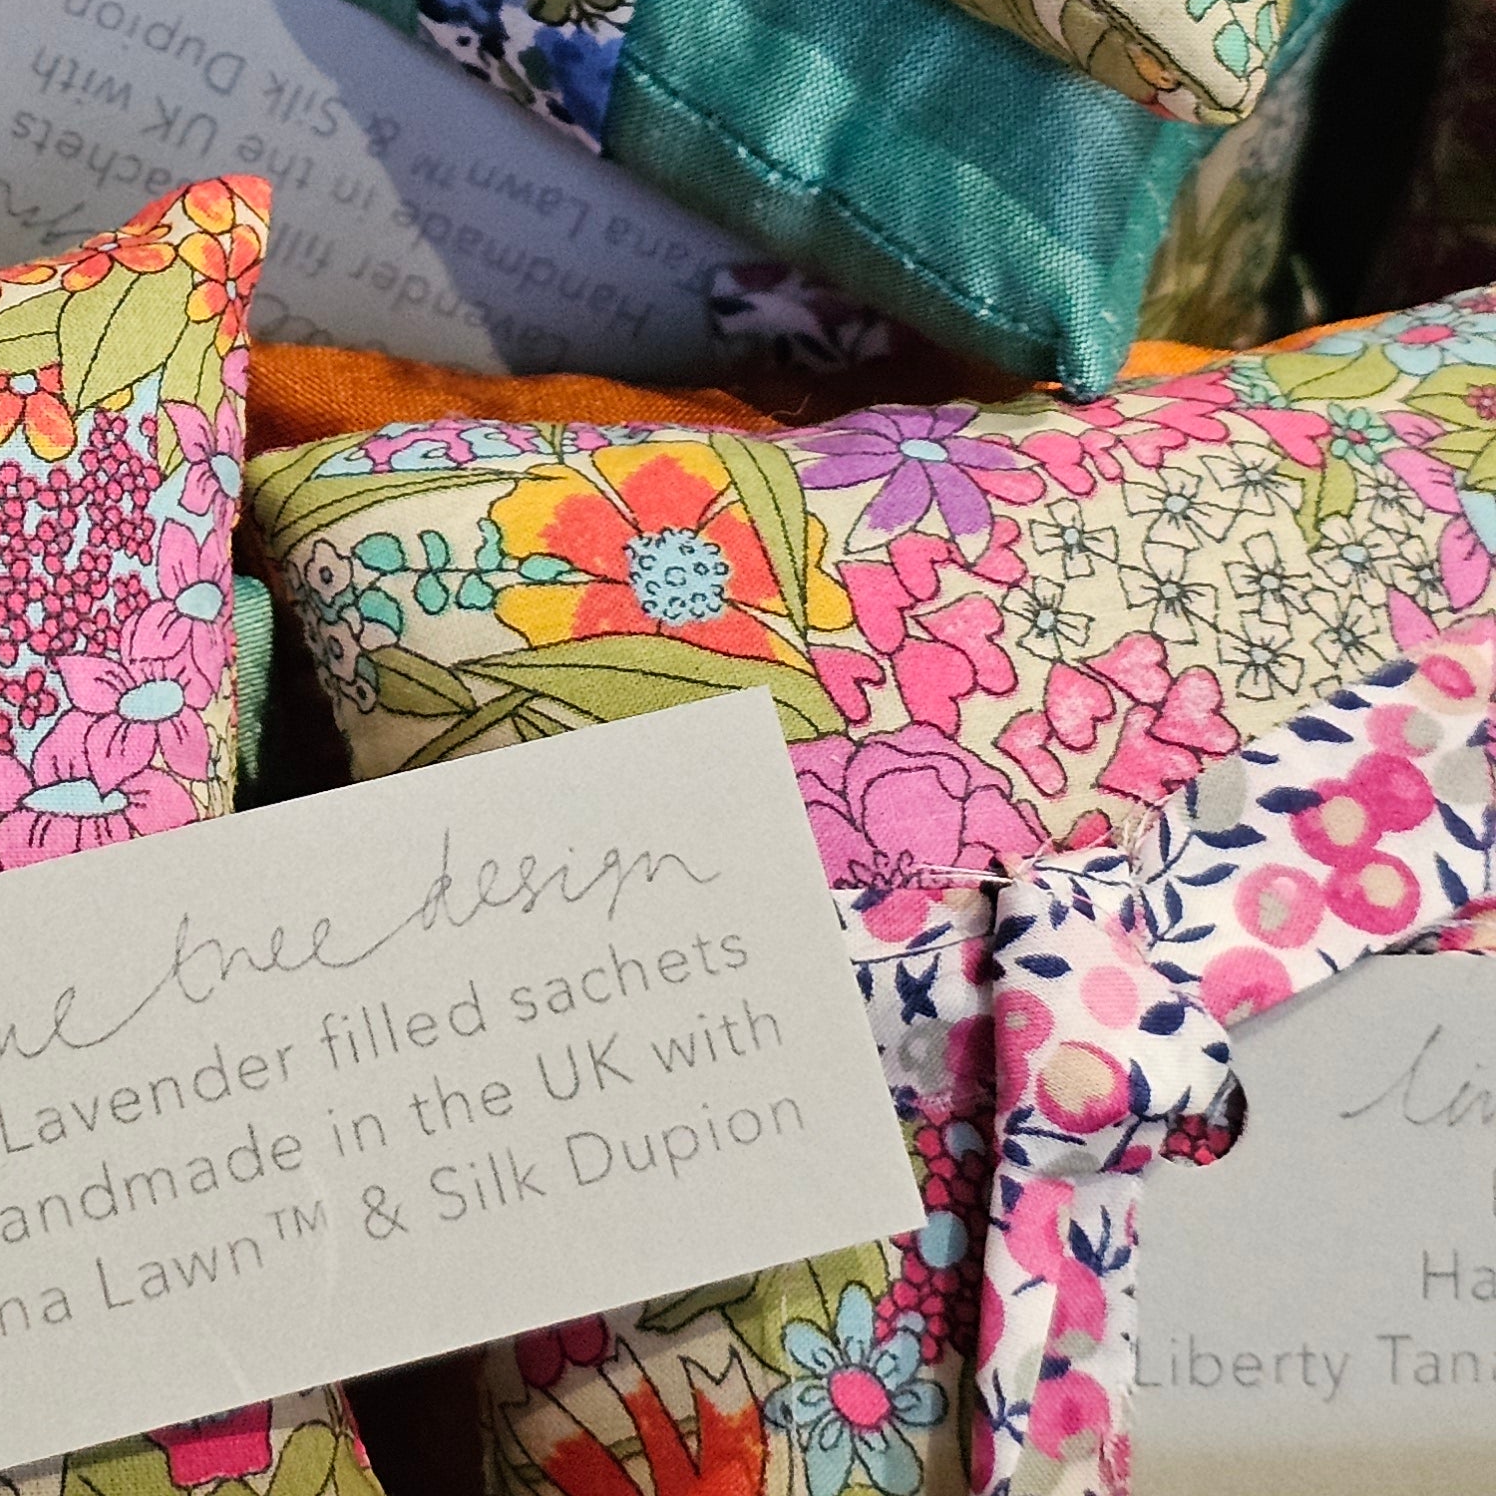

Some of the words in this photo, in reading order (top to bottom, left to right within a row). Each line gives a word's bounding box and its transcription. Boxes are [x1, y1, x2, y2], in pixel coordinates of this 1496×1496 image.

[30, 45, 134, 112] with
[261, 69, 346, 139] Silk
[10, 108, 193, 197] achets
[140, 94, 219, 156] UK
[367, 112, 401, 158] &
[236, 133, 317, 191] the
[332, 174, 376, 223] in
[144, 912, 374, 1003] tree
[394, 826, 722, 931] design
[320, 979, 488, 1071] filled
[509, 932, 750, 1024] sachets
[326, 1108, 388, 1158] in
[408, 1073, 515, 1136] the
[536, 1031, 635, 1101] UK
[650, 998, 784, 1075] with
[360, 1184, 409, 1240] &
[428, 1146, 548, 1222] Silk
[565, 1096, 807, 1186] Dupion
[1130, 1334, 1351, 1404] Liberty
[1376, 1333, 1496, 1386] Tan
